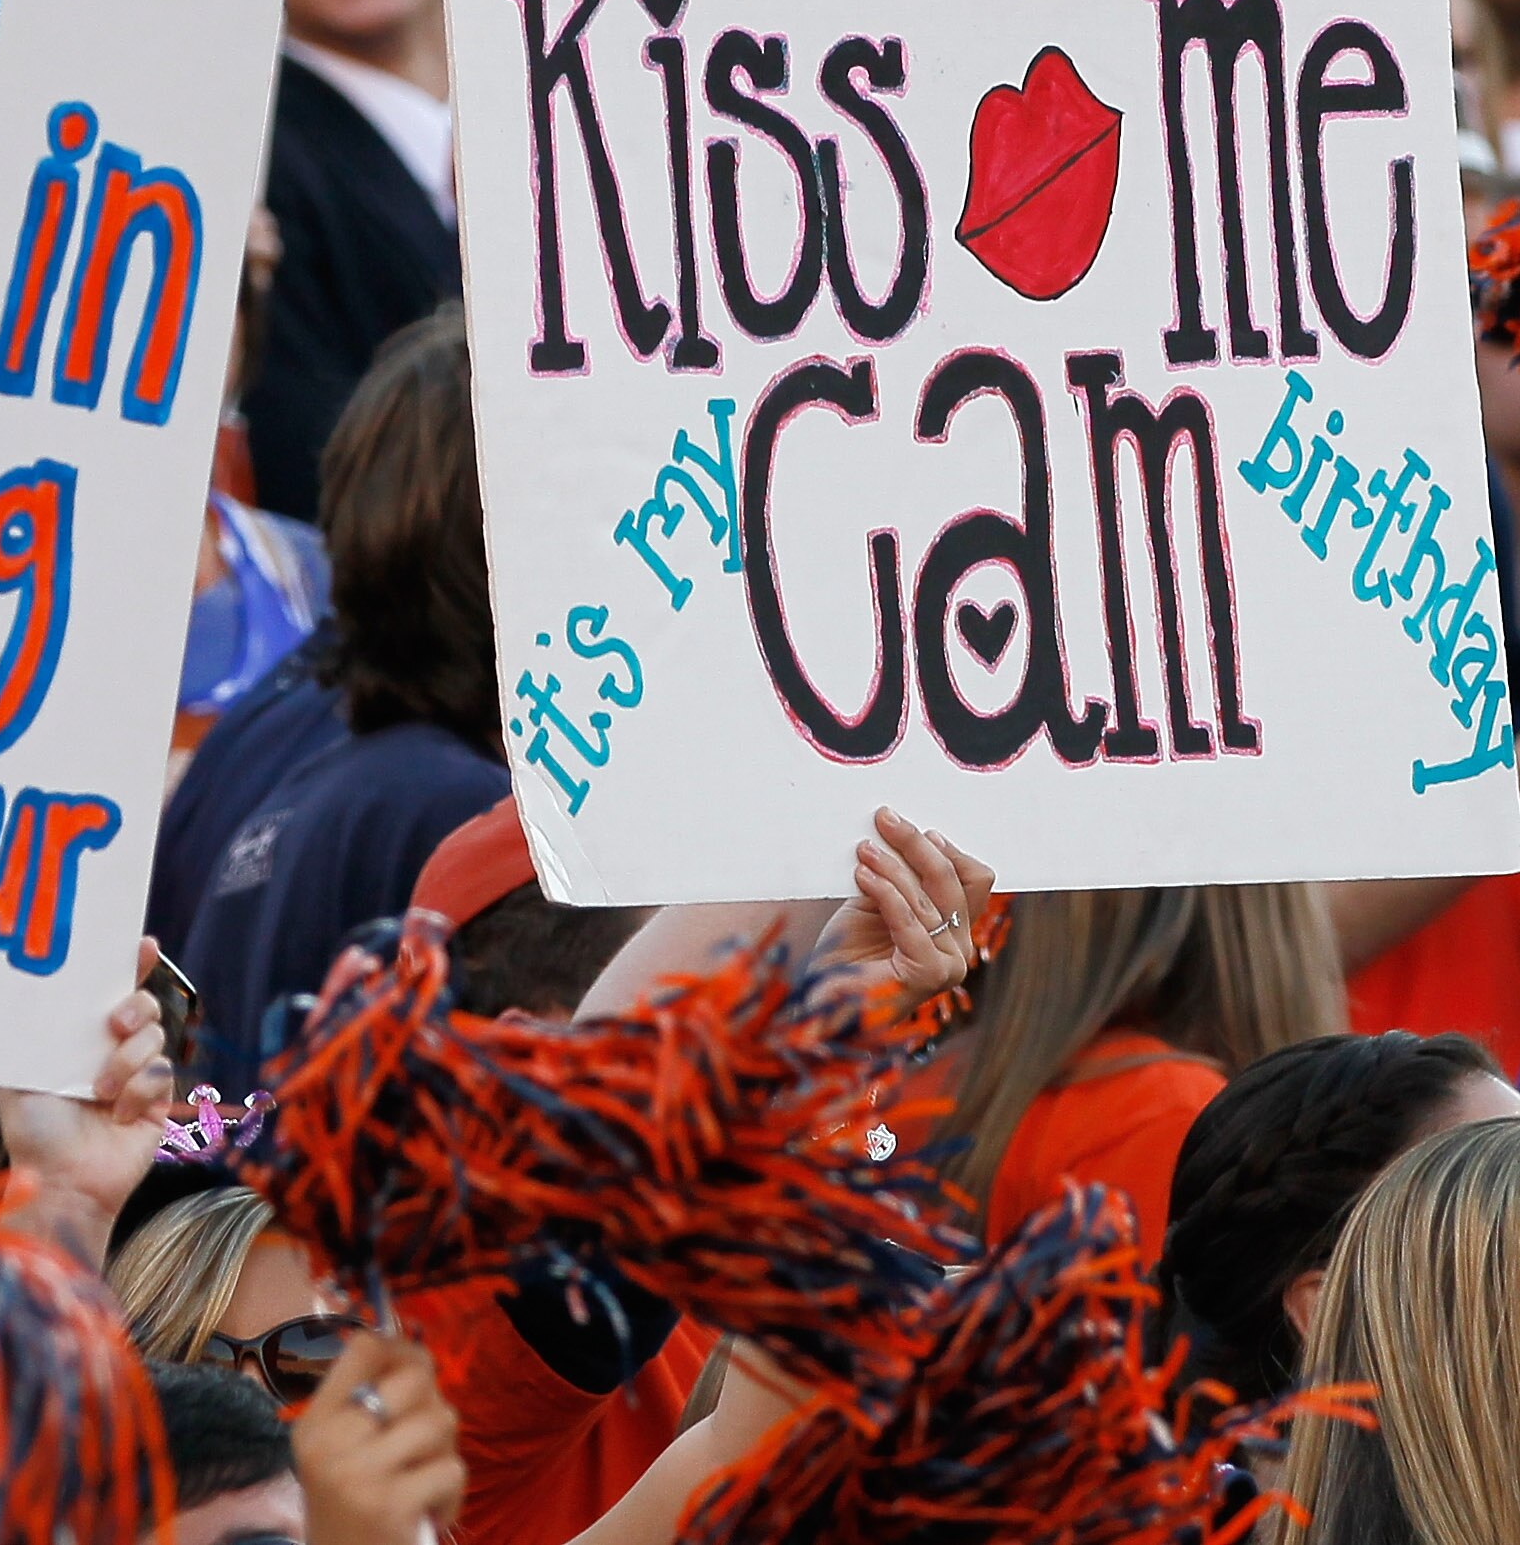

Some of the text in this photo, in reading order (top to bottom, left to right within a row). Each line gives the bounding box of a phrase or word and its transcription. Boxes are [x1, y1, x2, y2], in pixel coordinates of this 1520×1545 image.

[510, 398, 743, 817] it's my
[741, 347, 1264, 772] Cam
[1237, 369, 1515, 795] birthday
